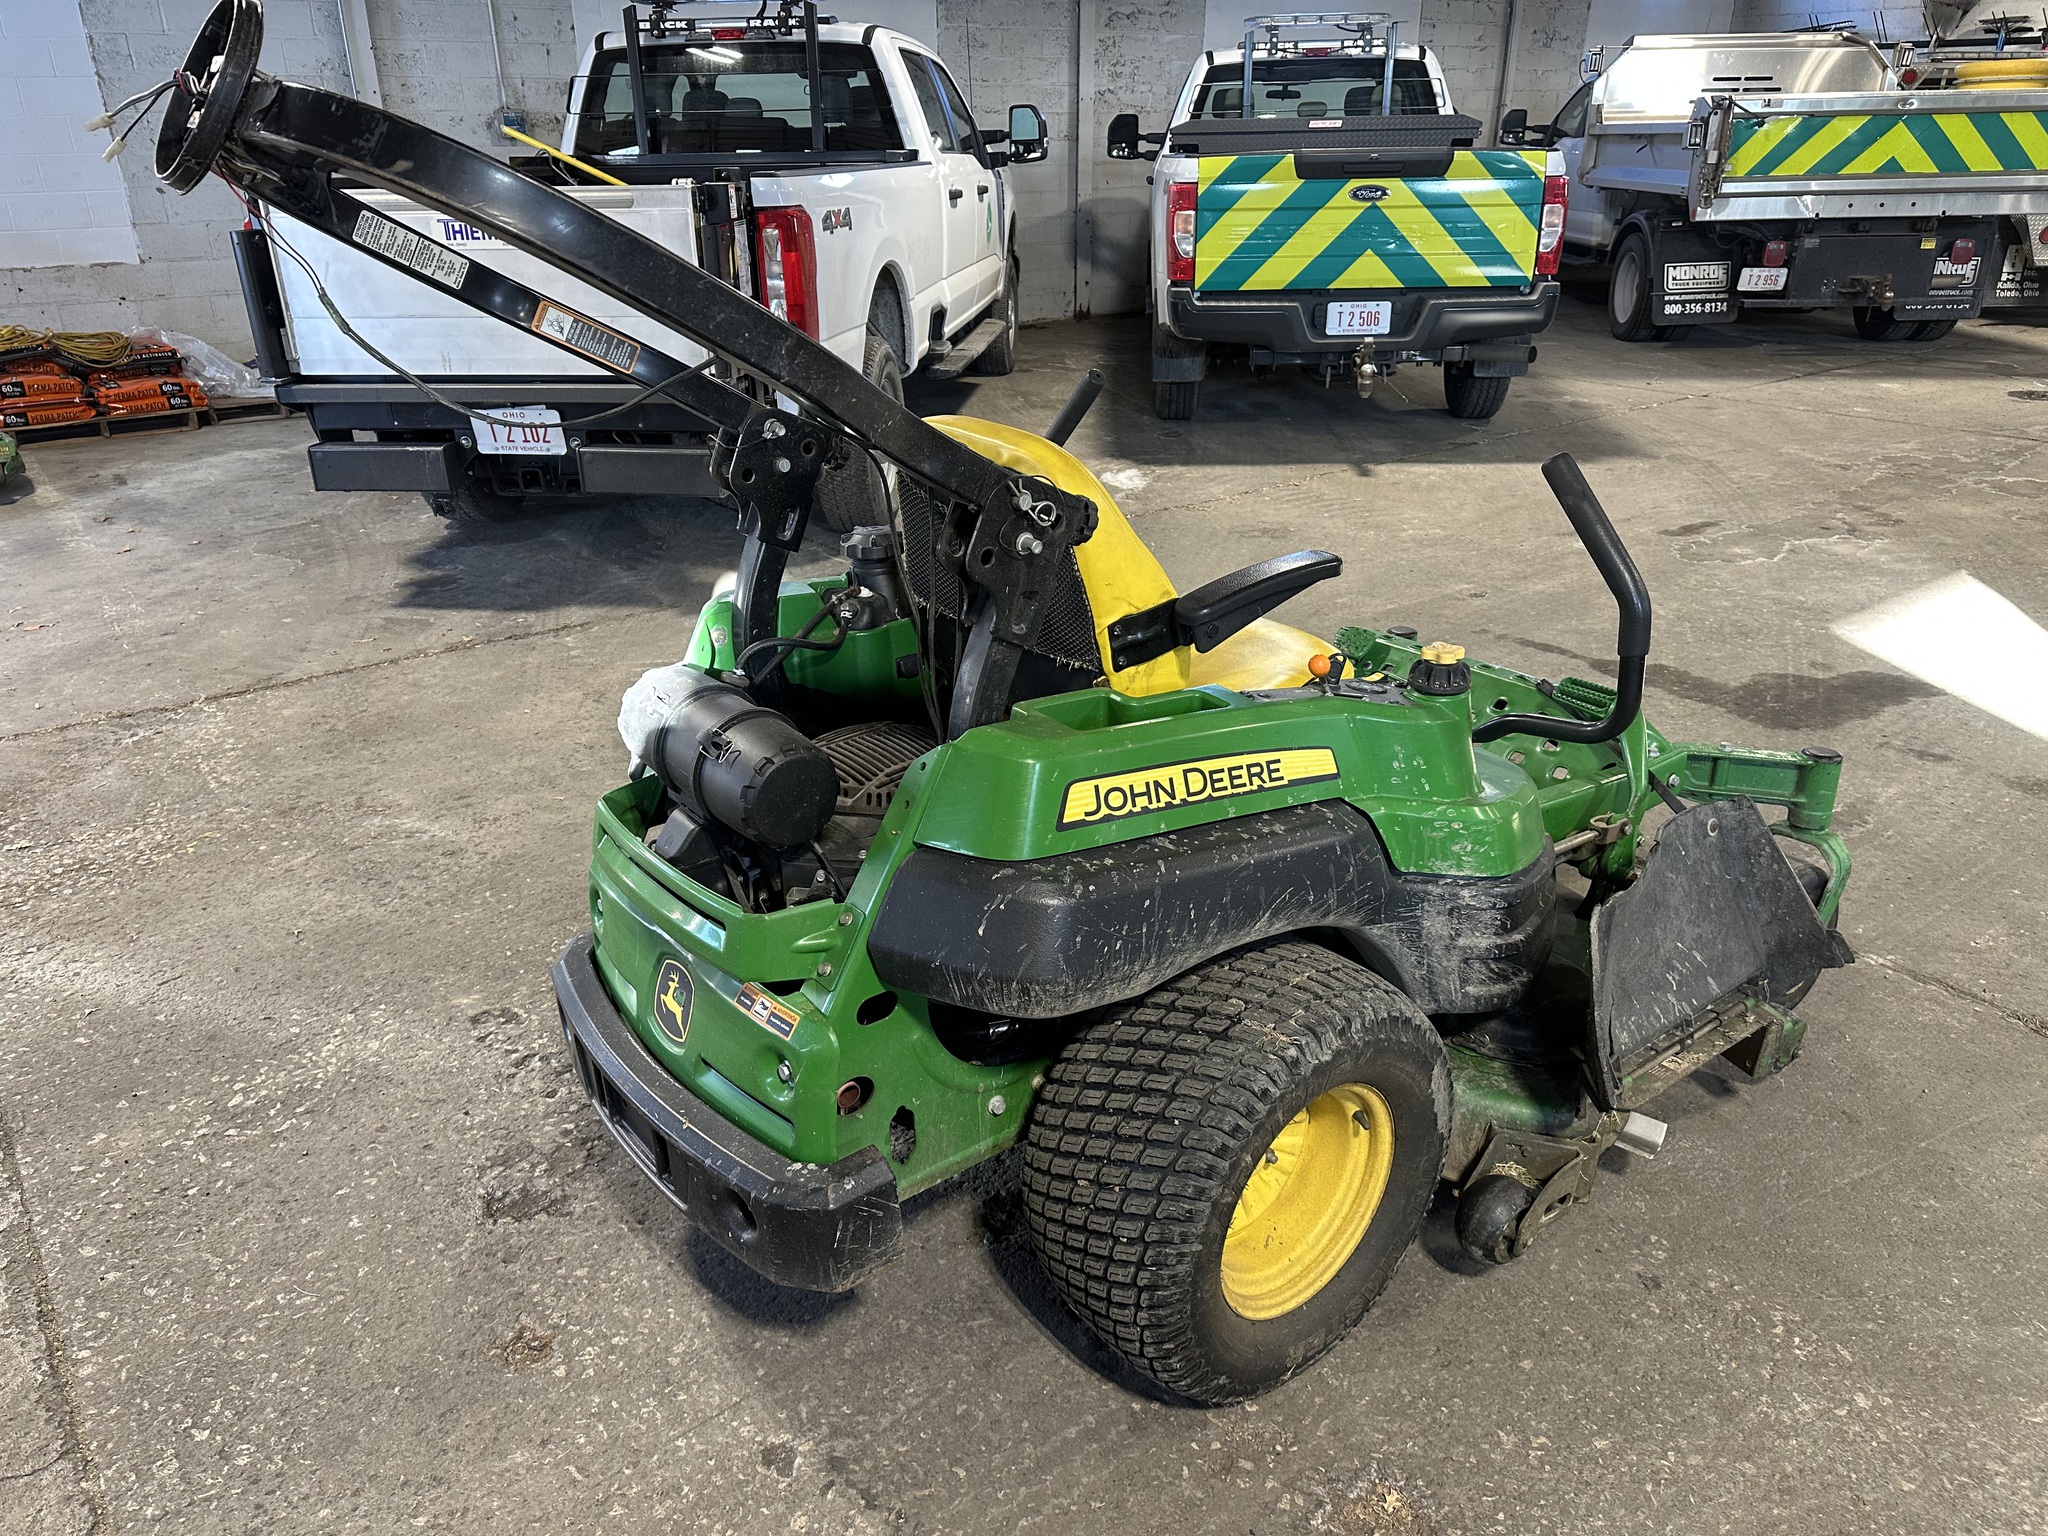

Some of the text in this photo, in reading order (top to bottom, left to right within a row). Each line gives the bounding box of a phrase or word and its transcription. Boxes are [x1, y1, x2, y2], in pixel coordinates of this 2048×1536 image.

[1343, 39, 1385, 47] RAK
[1356, 187, 1382, 199] Ford
[1668, 264, 1728, 280] MONROE
[1933, 260, 1978, 275] NROE
[1747, 274, 1780, 286] T 2 956
[1996, 281, 2040, 290] Kalida, Ohio
[1995, 289, 2040, 298] Toledo, Ohio
[1664, 302, 1728, 315] 800-356-8134
[1337, 311, 1380, 327] T 2 506
[2, 385, 13, 393] 60
[27, 384, 75, 394] PERMA-PATCH
[114, 388, 158, 400] PERMA-PATCH
[170, 397, 181, 405] 60
[6, 415, 17, 423] 60
[31, 411, 78, 424] PERMA-PATCH
[502, 411, 525, 419] OHIO
[1084, 758, 1285, 817] JOHN DEERE
